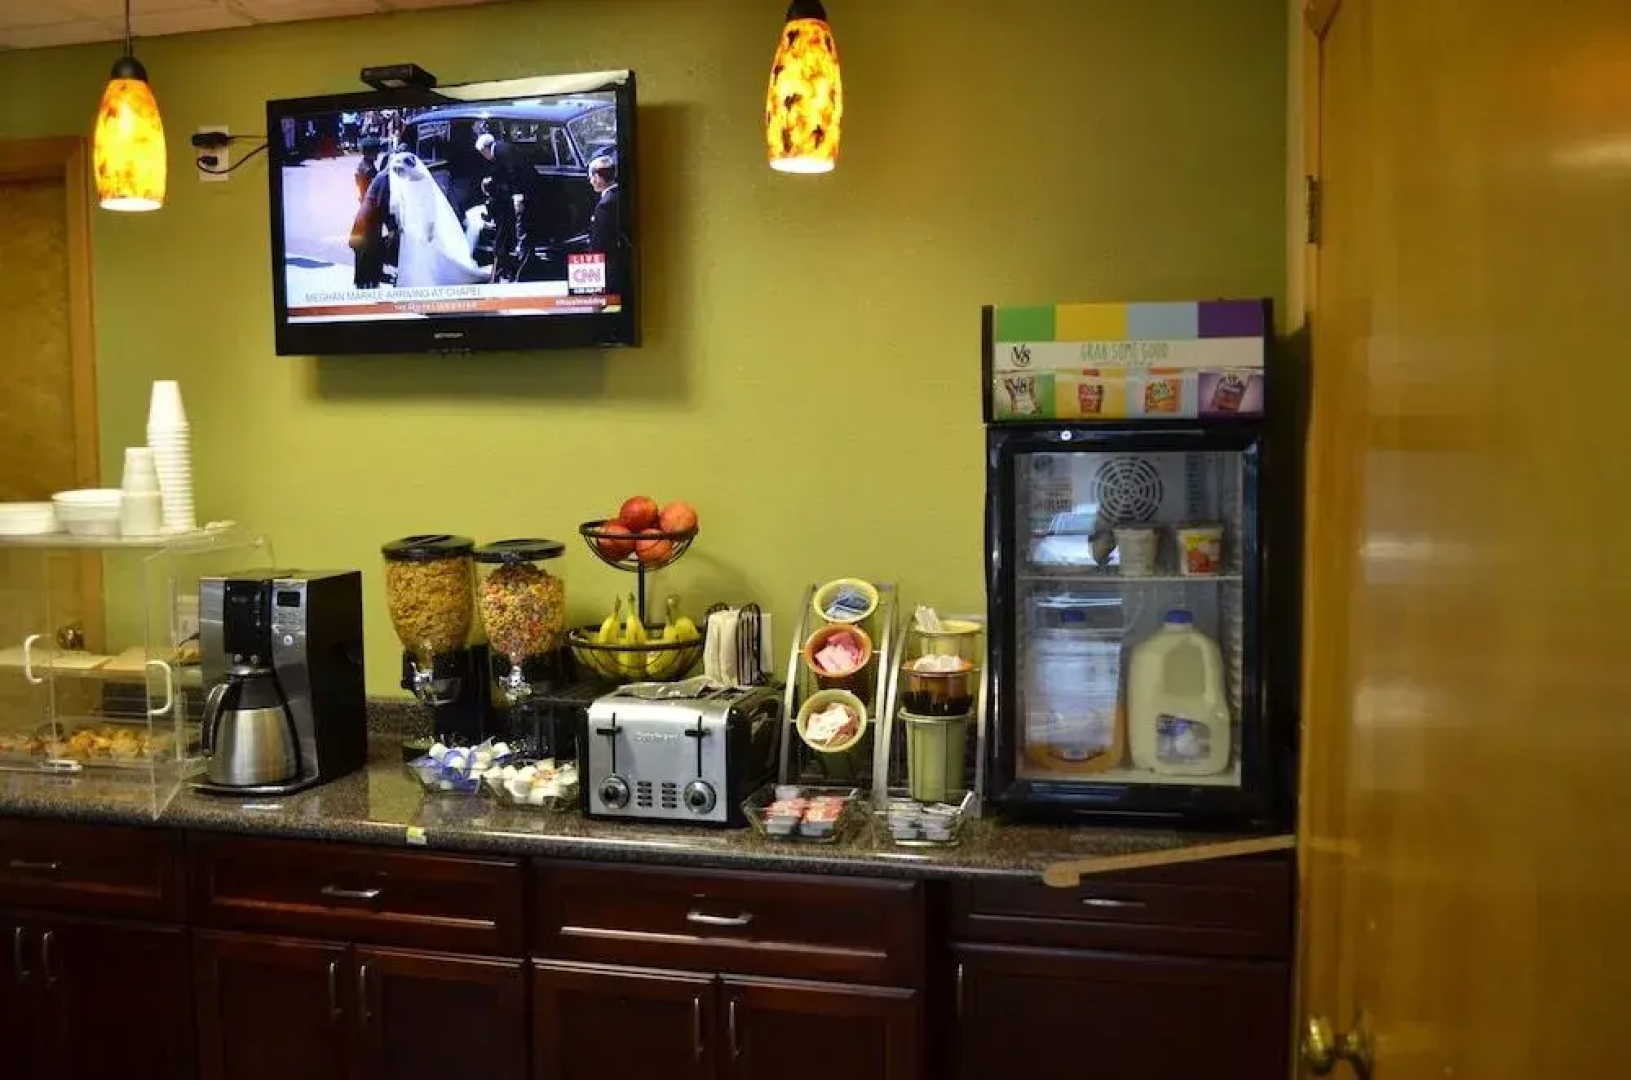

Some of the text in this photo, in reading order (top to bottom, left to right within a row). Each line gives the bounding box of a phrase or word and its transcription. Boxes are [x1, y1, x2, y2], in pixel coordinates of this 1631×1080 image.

[573, 269, 601, 283] CNN
[305, 286, 482, 302] MEGHAN MARKLE ARRIVING AT CHAPEL
